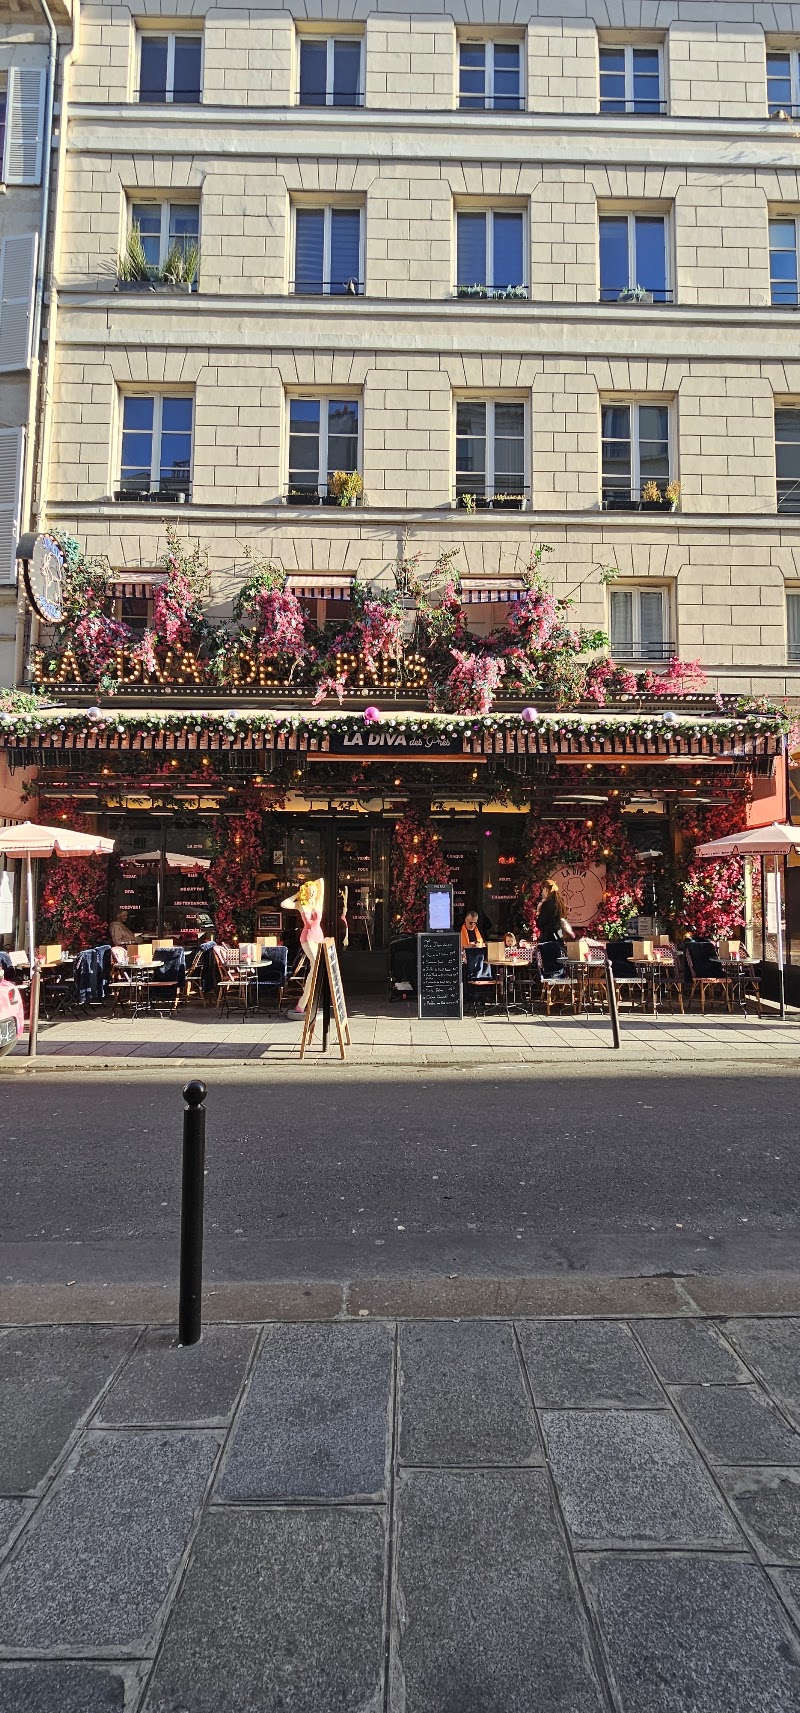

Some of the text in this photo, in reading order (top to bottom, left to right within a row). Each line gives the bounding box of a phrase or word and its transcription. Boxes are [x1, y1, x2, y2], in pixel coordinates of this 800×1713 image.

[34, 650, 82, 683] LA
[343, 733, 363, 746] LA
[367, 733, 407, 746] DIVA
[561, 870, 570, 878] LA
